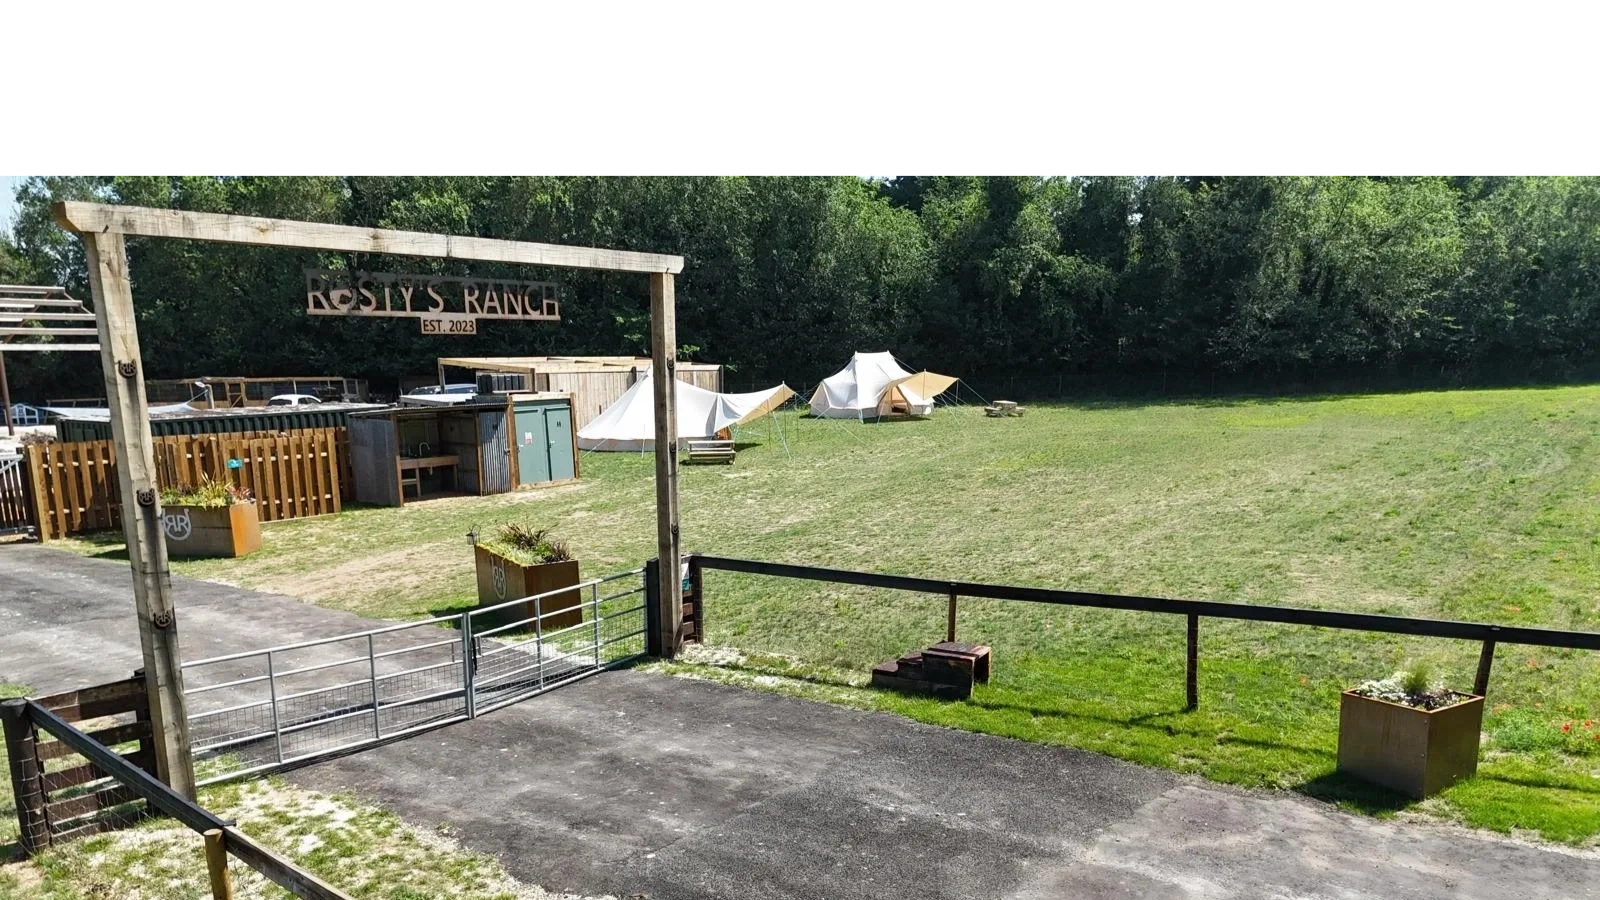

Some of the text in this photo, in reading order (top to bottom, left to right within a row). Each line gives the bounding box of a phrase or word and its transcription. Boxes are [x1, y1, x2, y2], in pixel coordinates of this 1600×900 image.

[463, 281, 559, 317] RANCH
[423, 319, 475, 333] EST. 2023
